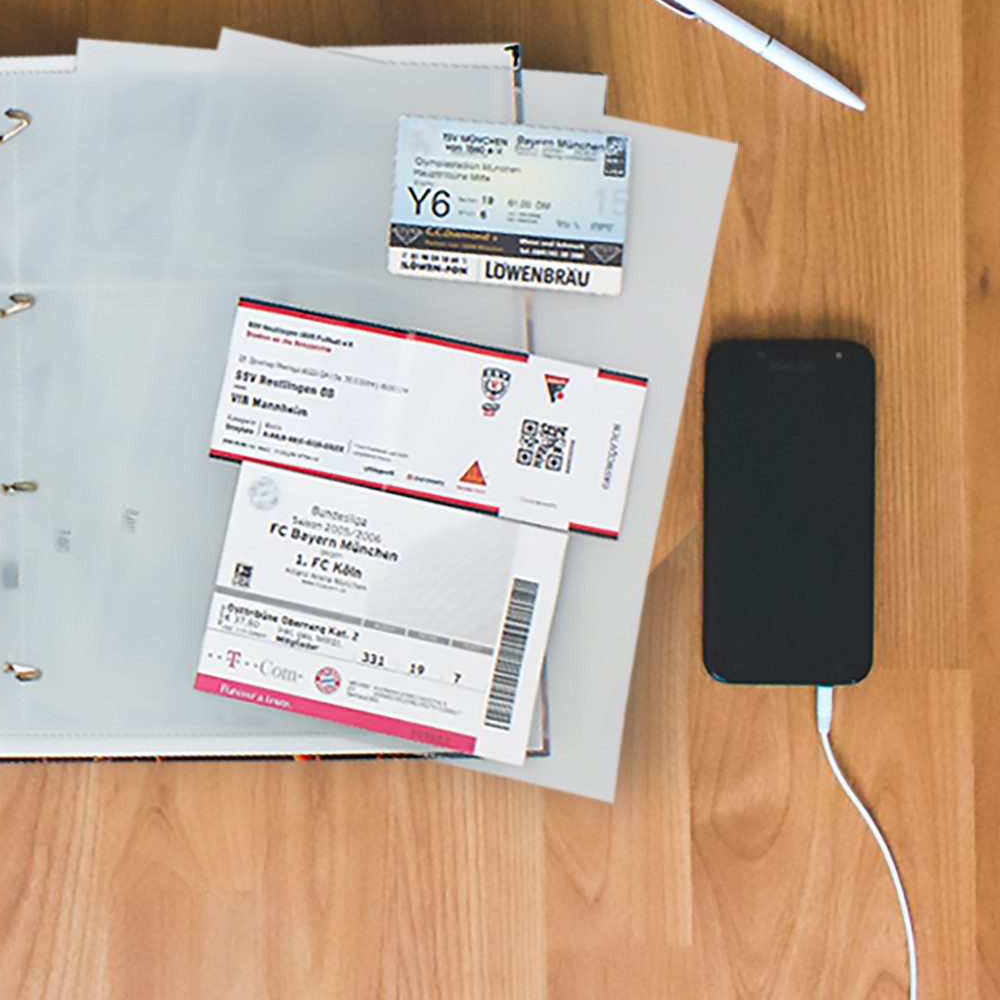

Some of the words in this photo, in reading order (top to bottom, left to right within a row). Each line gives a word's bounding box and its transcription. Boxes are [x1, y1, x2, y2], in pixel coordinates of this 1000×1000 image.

[408, 186, 450, 218] Y6
[485, 260, 591, 287] LÖWENBRÄU
[234, 369, 257, 383] SSV
[252, 396, 309, 417] Mannheim
[311, 505, 368, 528] Bundesliga
[270, 522, 288, 537] FC
[290, 529, 337, 549] Bayern
[340, 539, 399, 562] München
[311, 556, 330, 571] FC
[332, 559, 363, 579] Köln
[361, 651, 385, 667] 331
[409, 662, 425, 675] 19
[453, 672, 462, 684] 7
